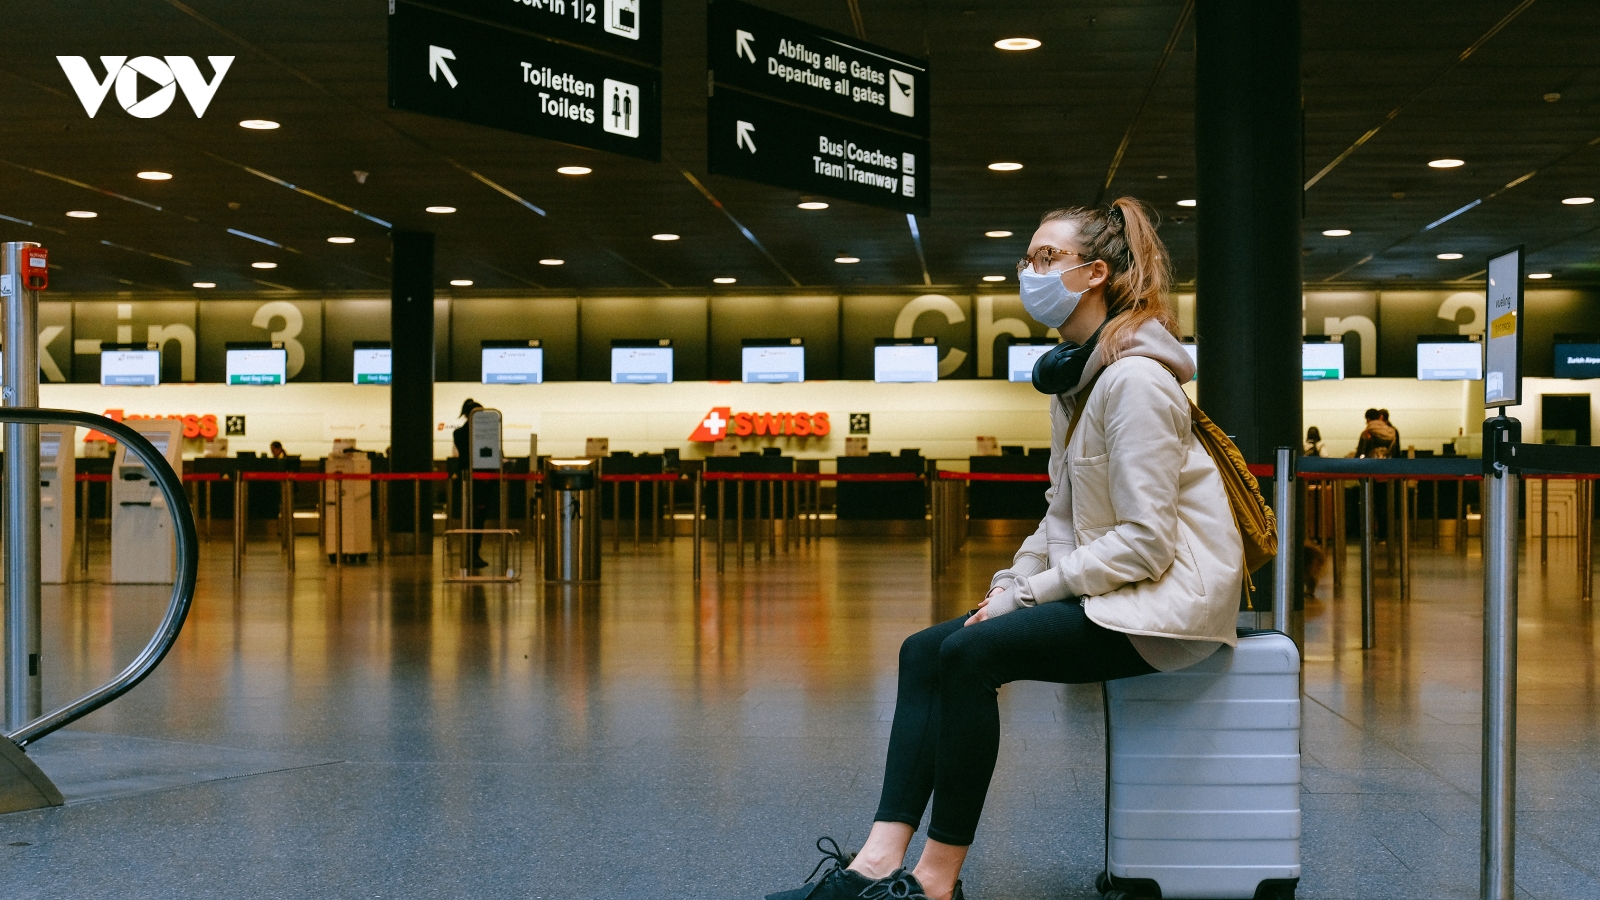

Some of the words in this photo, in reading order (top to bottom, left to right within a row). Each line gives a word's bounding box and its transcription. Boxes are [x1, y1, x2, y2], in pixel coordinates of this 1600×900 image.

[778, 38, 820, 69] Abflug
[824, 54, 847, 73] alle
[850, 61, 885, 85] Gates
[520, 61, 595, 98] Toiletten
[768, 57, 831, 90] Departure
[834, 78, 849, 96] all
[852, 86, 885, 106] gates
[538, 92, 595, 124] Toilets
[847, 143, 898, 170] Coaches
[1495, 293, 1511, 309] vueling
[734, 411, 830, 436] SWISS
